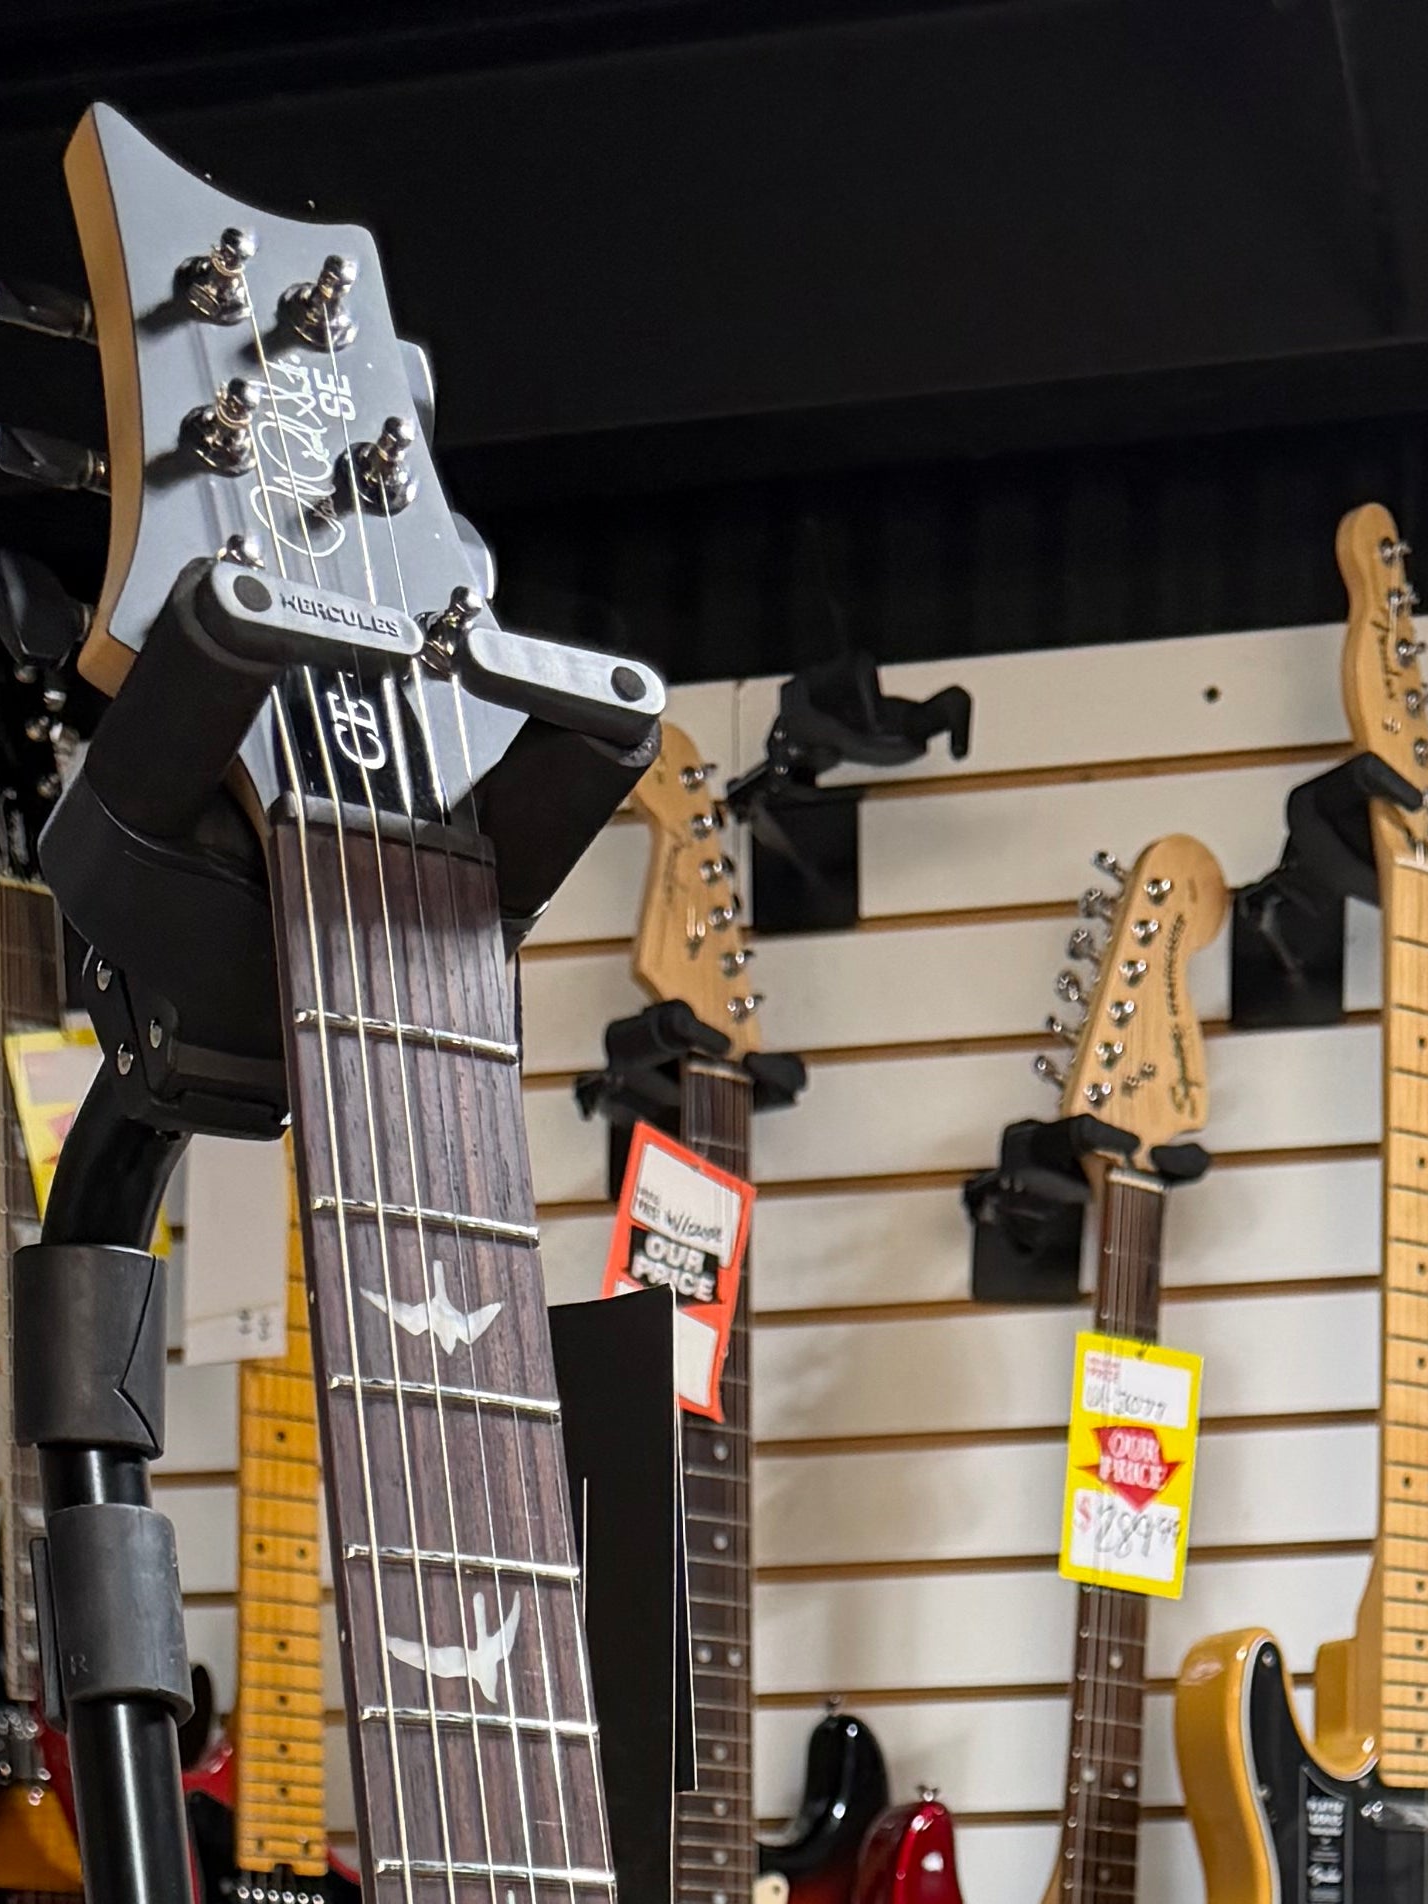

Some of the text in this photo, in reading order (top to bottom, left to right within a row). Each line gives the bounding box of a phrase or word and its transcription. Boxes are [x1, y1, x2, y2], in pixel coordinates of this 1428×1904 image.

[279, 592, 401, 638] HERCULES
[644, 1234, 706, 1274] OUR
[630, 1253, 717, 1302] PRICE
[1108, 1430, 1161, 1466] OUR
[1099, 1455, 1170, 1492] PRICE
